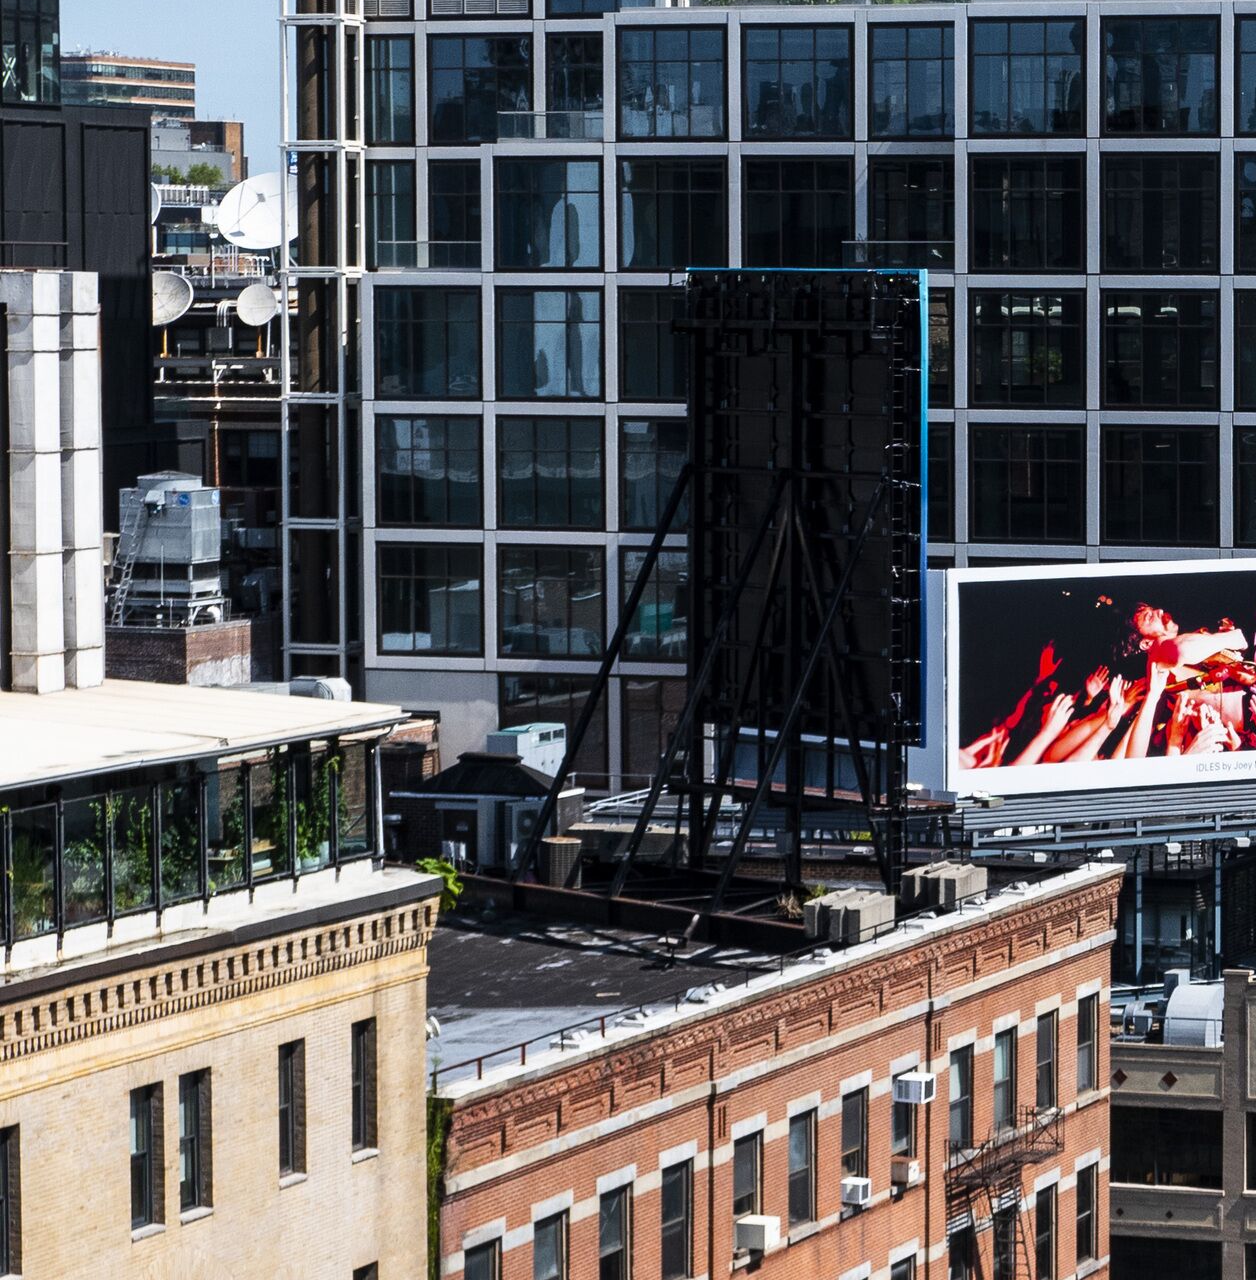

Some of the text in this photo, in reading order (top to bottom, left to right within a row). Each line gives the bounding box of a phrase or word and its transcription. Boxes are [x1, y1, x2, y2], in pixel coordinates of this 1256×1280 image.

[1196, 762, 1221, 772] IDLES
[1222, 762, 1232, 771] by
[1234, 761, 1253, 771] Joey
